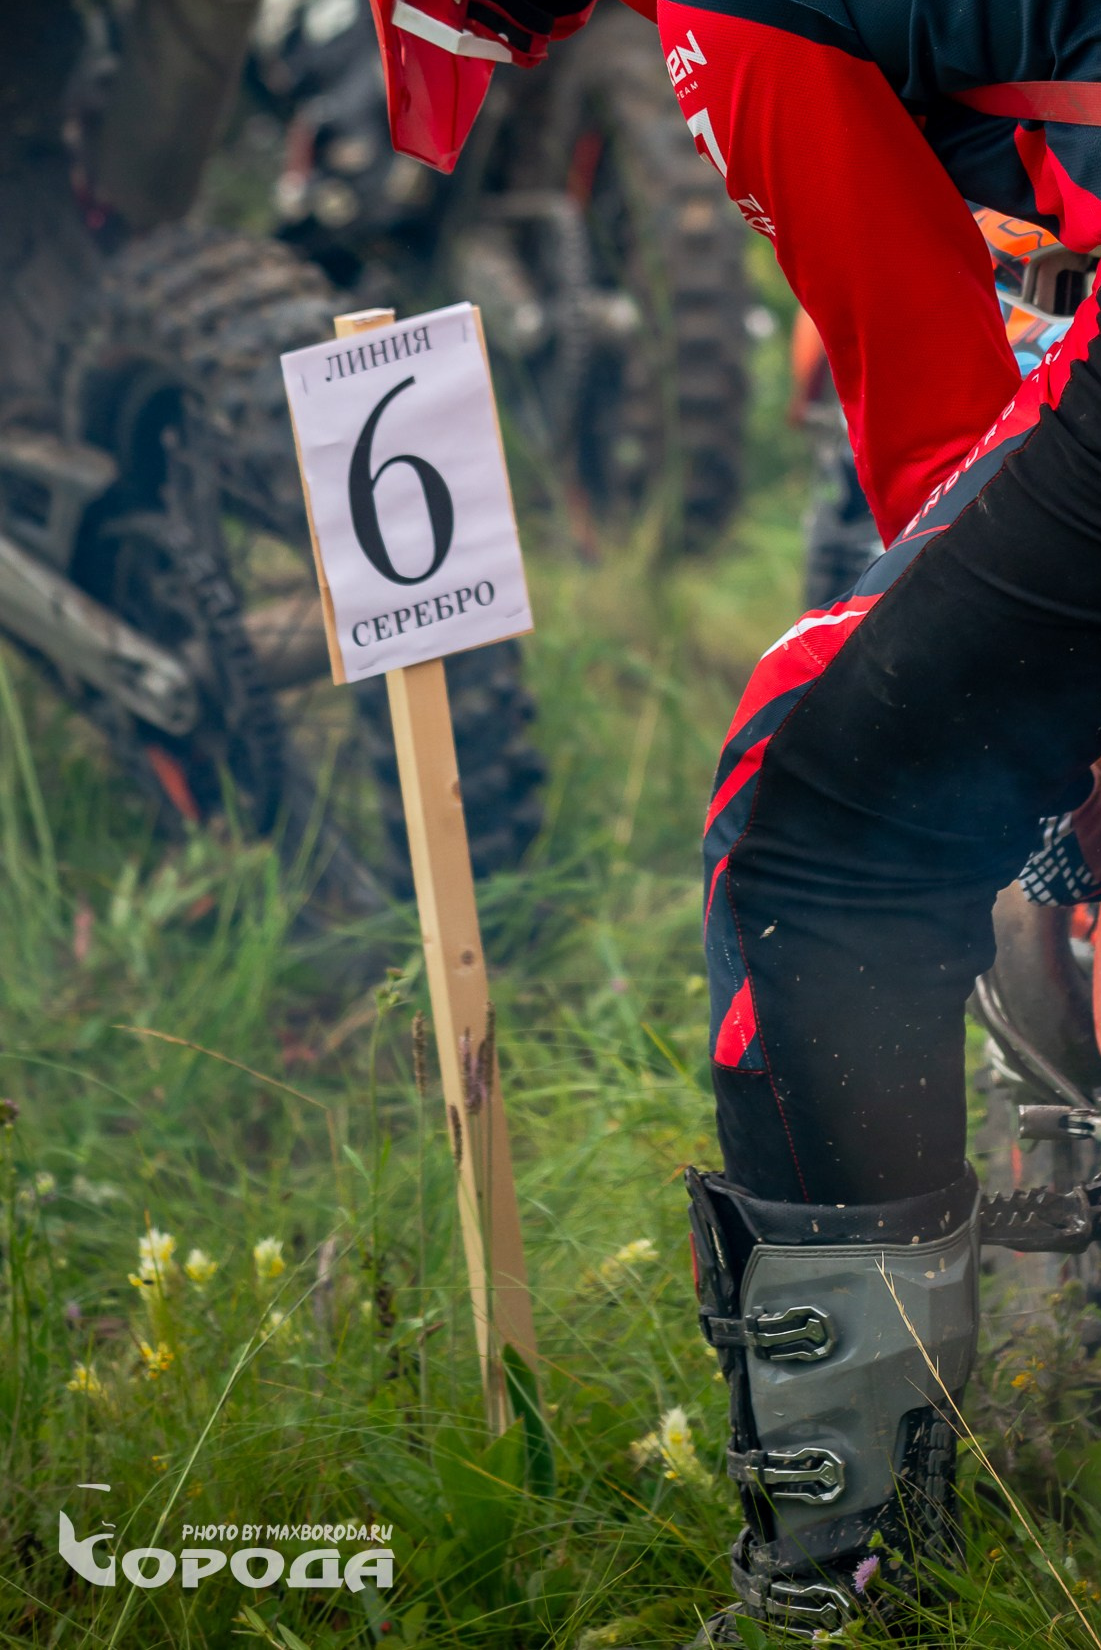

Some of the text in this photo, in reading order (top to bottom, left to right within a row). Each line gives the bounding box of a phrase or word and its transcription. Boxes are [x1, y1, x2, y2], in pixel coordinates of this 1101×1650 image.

[325, 326, 433, 382] ЛИНИЯ
[348, 375, 455, 586] 6
[351, 580, 495, 647] СЕРЕБРО
